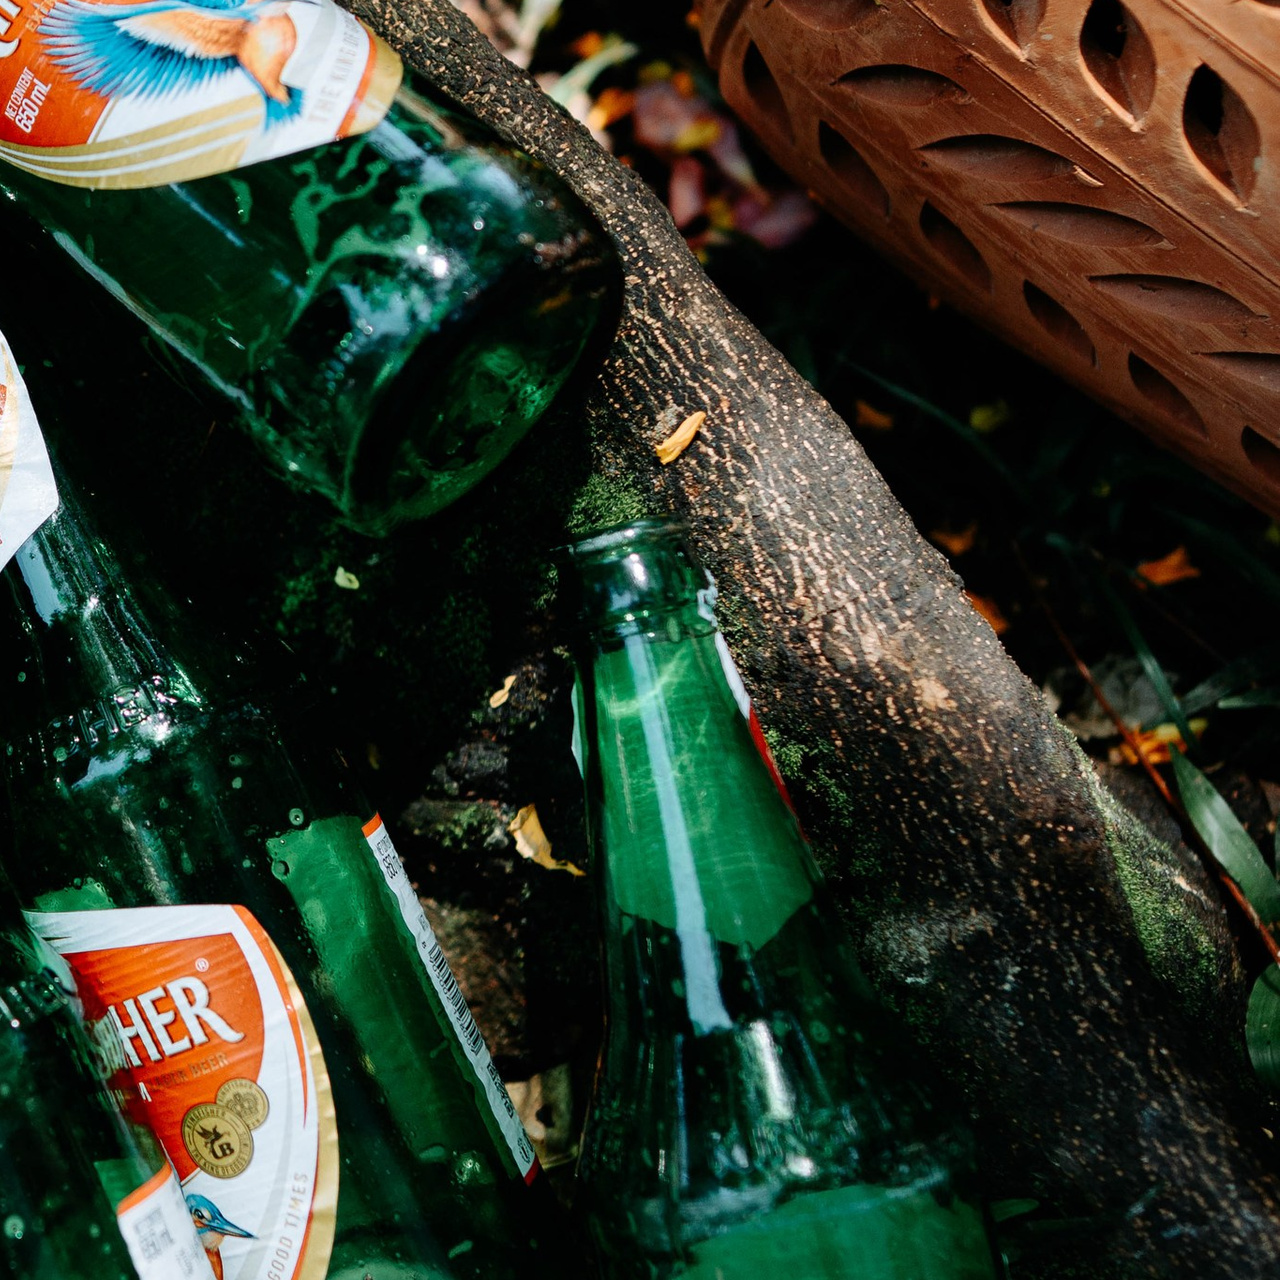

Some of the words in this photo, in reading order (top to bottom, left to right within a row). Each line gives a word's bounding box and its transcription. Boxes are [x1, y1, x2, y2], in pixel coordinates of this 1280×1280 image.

[10, 66, 35, 106] CONTENT
[15, 98, 39, 134] 650
[30, 77, 52, 106] mL
[4, 100, 18, 122] NET
[189, 1053, 229, 1077] BEER
[283, 1171, 310, 1229] TIMES
